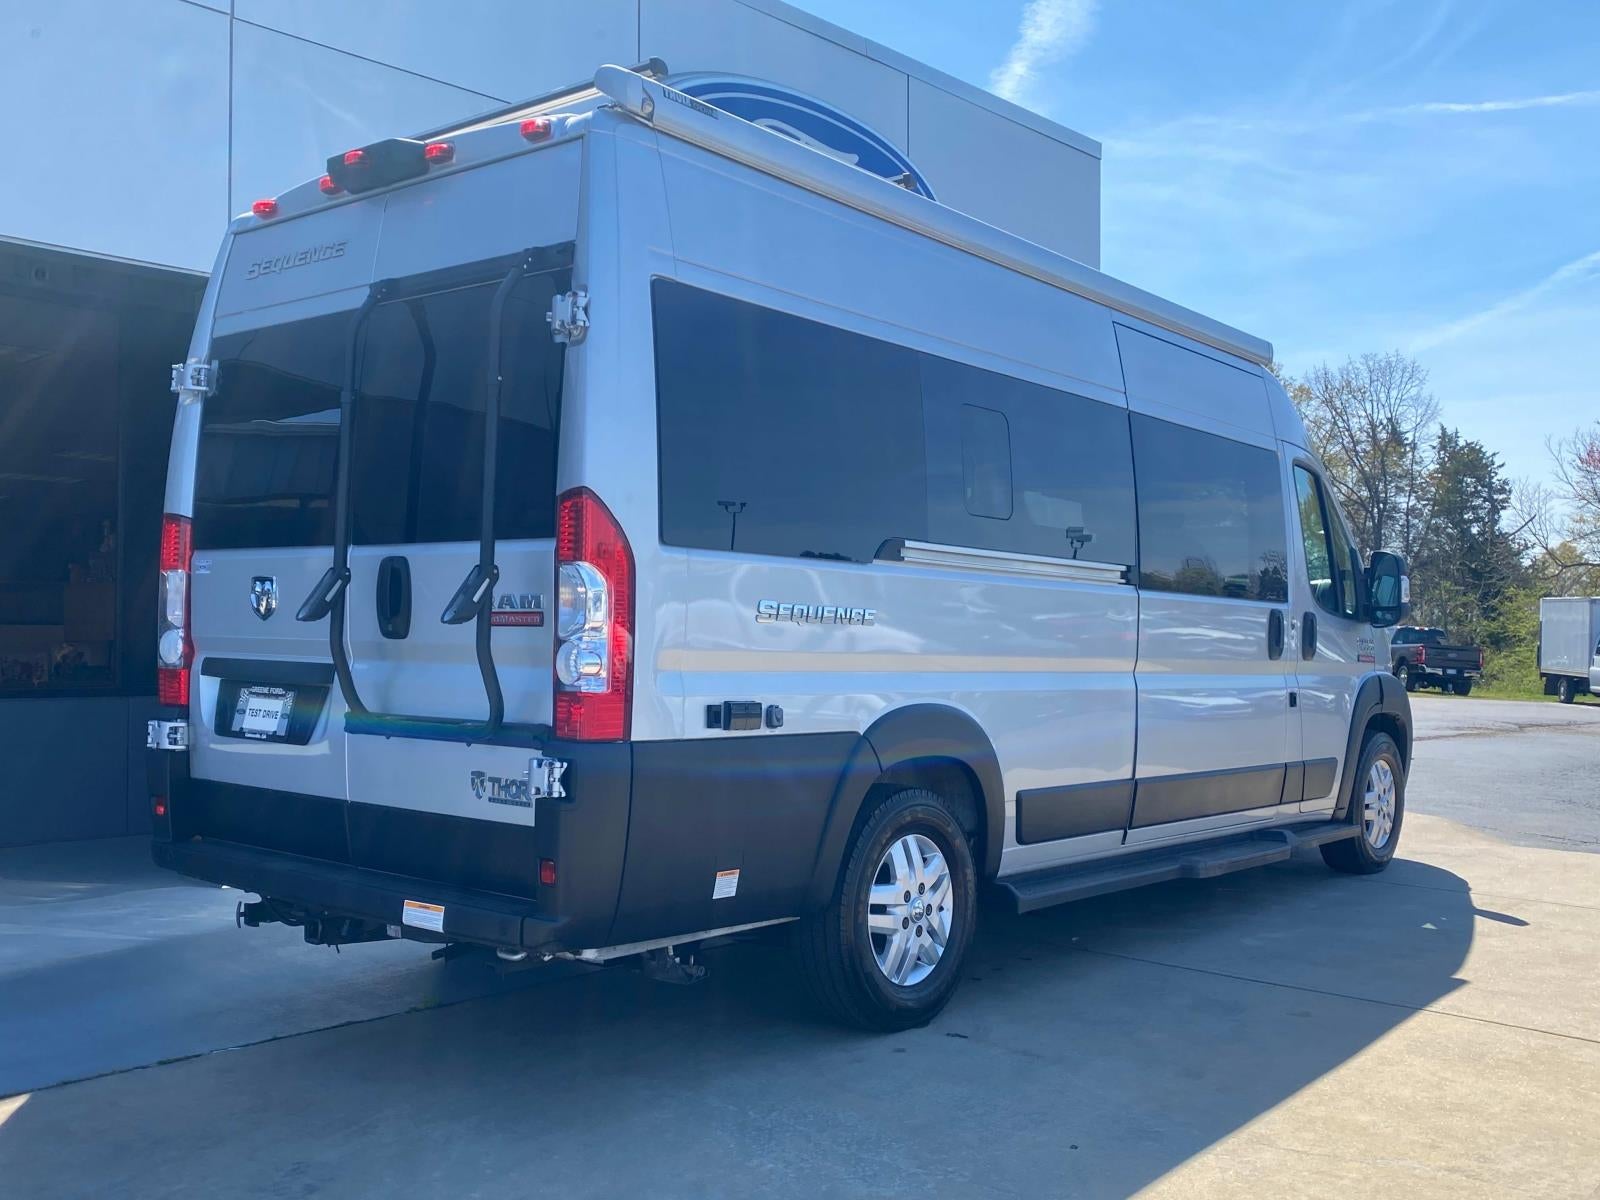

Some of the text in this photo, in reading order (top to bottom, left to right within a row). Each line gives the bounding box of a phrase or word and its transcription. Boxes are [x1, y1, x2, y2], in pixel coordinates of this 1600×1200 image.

[244, 241, 347, 280] SEQUENCE
[492, 593, 544, 609] AM
[756, 599, 877, 626] SEQUENCE
[270, 687, 284, 695] FORD
[248, 708, 279, 720] TEST DRIVE
[488, 776, 532, 801] THOR
